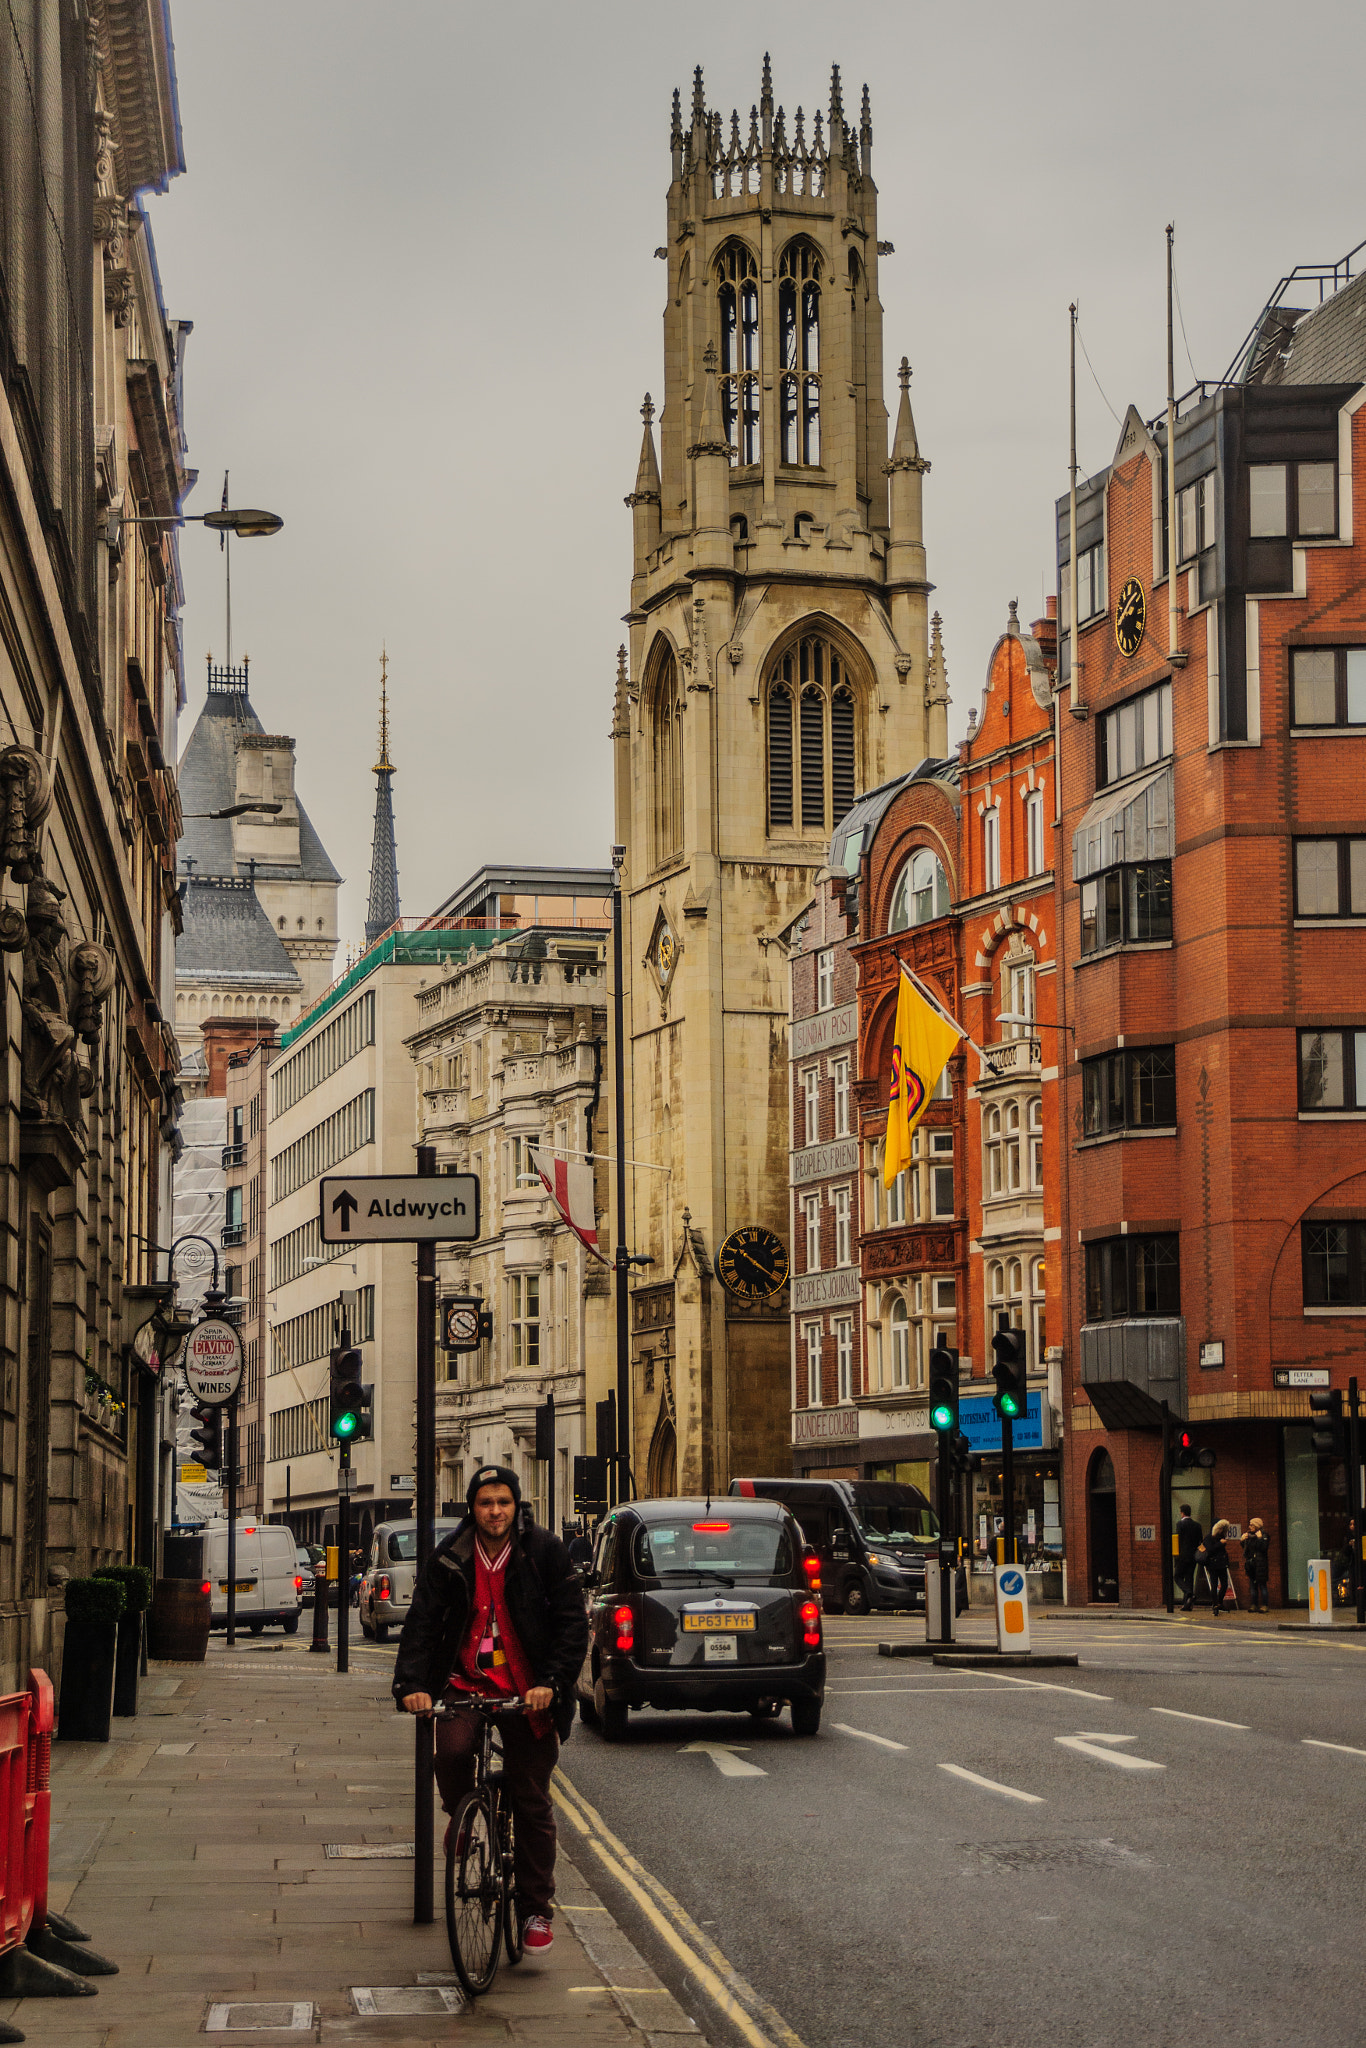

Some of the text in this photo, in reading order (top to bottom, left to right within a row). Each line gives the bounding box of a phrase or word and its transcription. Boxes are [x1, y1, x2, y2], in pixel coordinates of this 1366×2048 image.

[797, 1010, 852, 1049] SUNDAY POST
[795, 1142, 858, 1178] PEOPLE'S FRIEND
[367, 1197, 467, 1220] Aldwych
[796, 1272, 860, 1305] PEOPLE'S JOURNAL
[197, 1382, 232, 1394] WINES
[796, 1413, 828, 1439] DUNDEE
[1139, 1527, 1152, 1539] 180
[1227, 1526, 1238, 1538] 80
[690, 1615, 749, 1627] LP63 FYH
